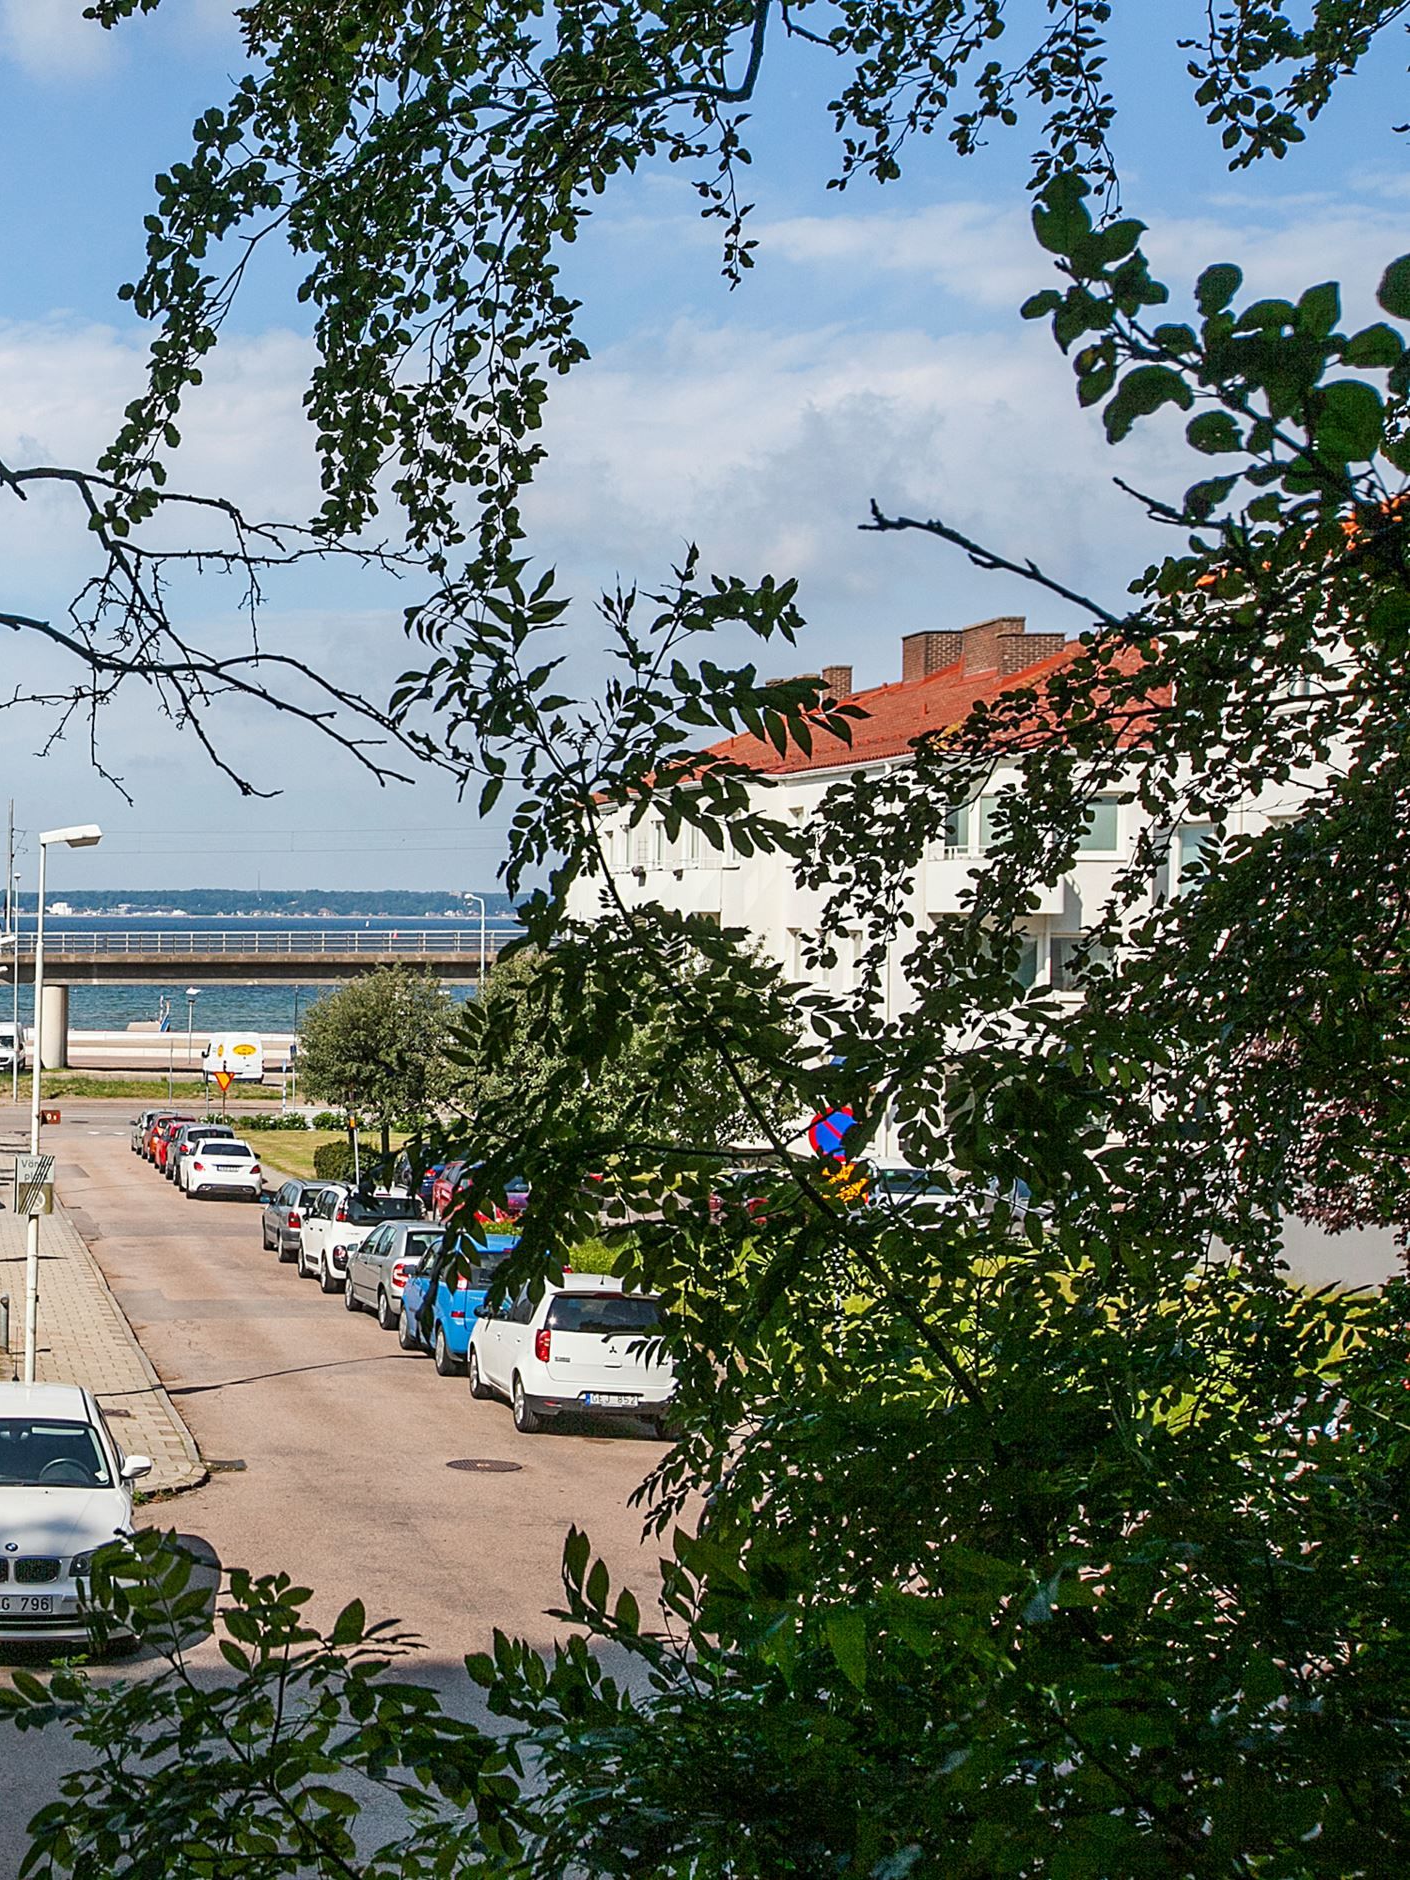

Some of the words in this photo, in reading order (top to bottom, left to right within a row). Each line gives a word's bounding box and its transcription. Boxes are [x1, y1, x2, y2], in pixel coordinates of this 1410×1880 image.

[591, 1394, 611, 1403] GEJ
[617, 1395, 636, 1405] 852
[20, 1597, 50, 1611] 796
